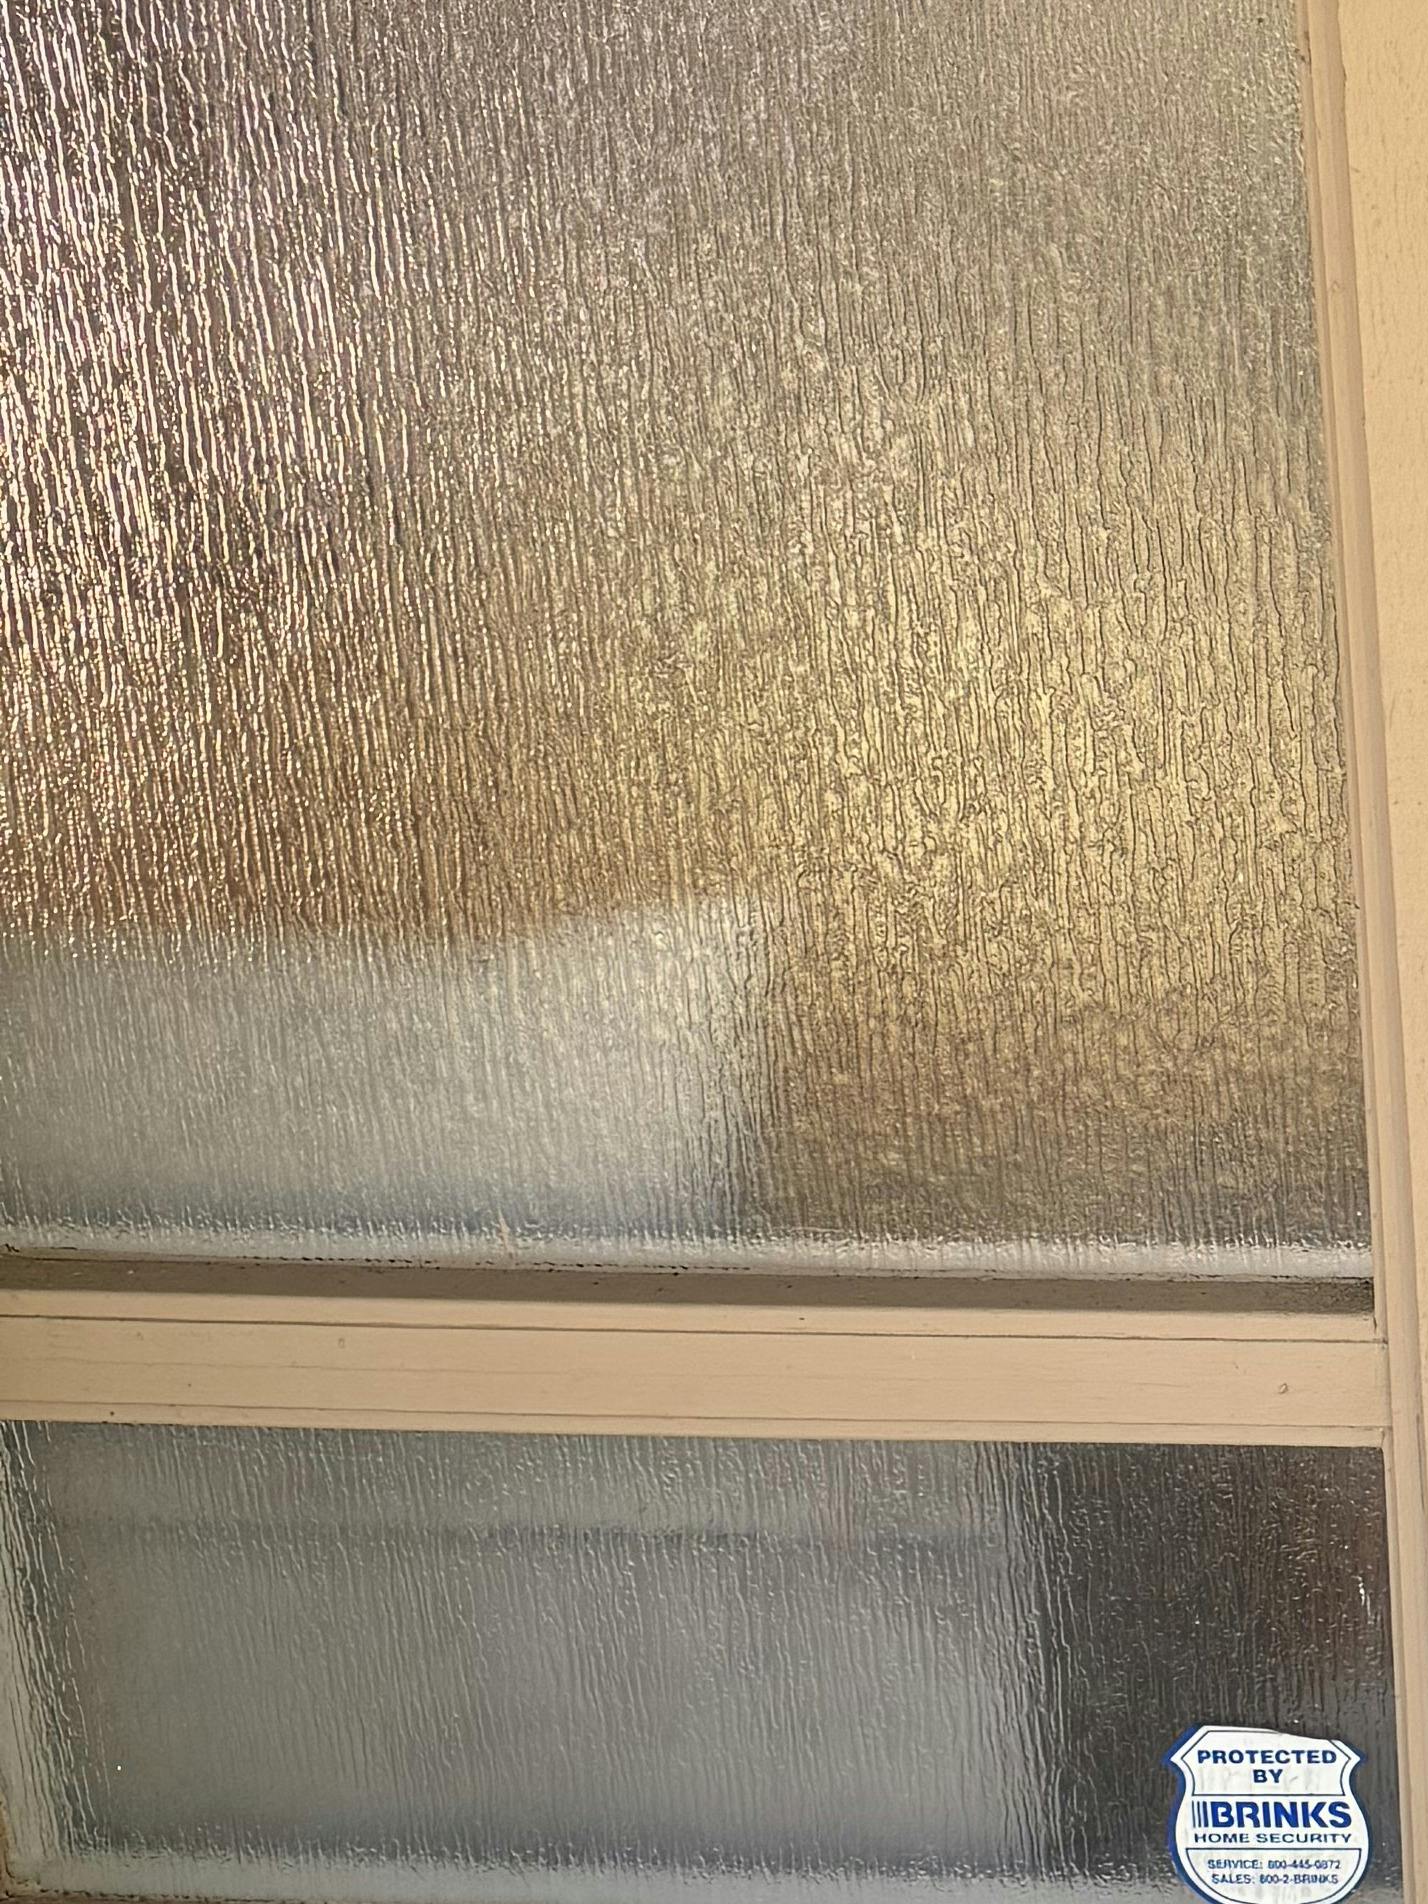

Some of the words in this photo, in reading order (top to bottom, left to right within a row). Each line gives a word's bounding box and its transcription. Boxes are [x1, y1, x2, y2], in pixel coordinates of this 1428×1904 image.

[1197, 1749, 1337, 1764] PROTECTED
[1252, 1769, 1284, 1783] BY
[1210, 1801, 1352, 1829] BRINKS
[1194, 1833, 1250, 1844] HOME
[1256, 1833, 1352, 1844] SECURITY
